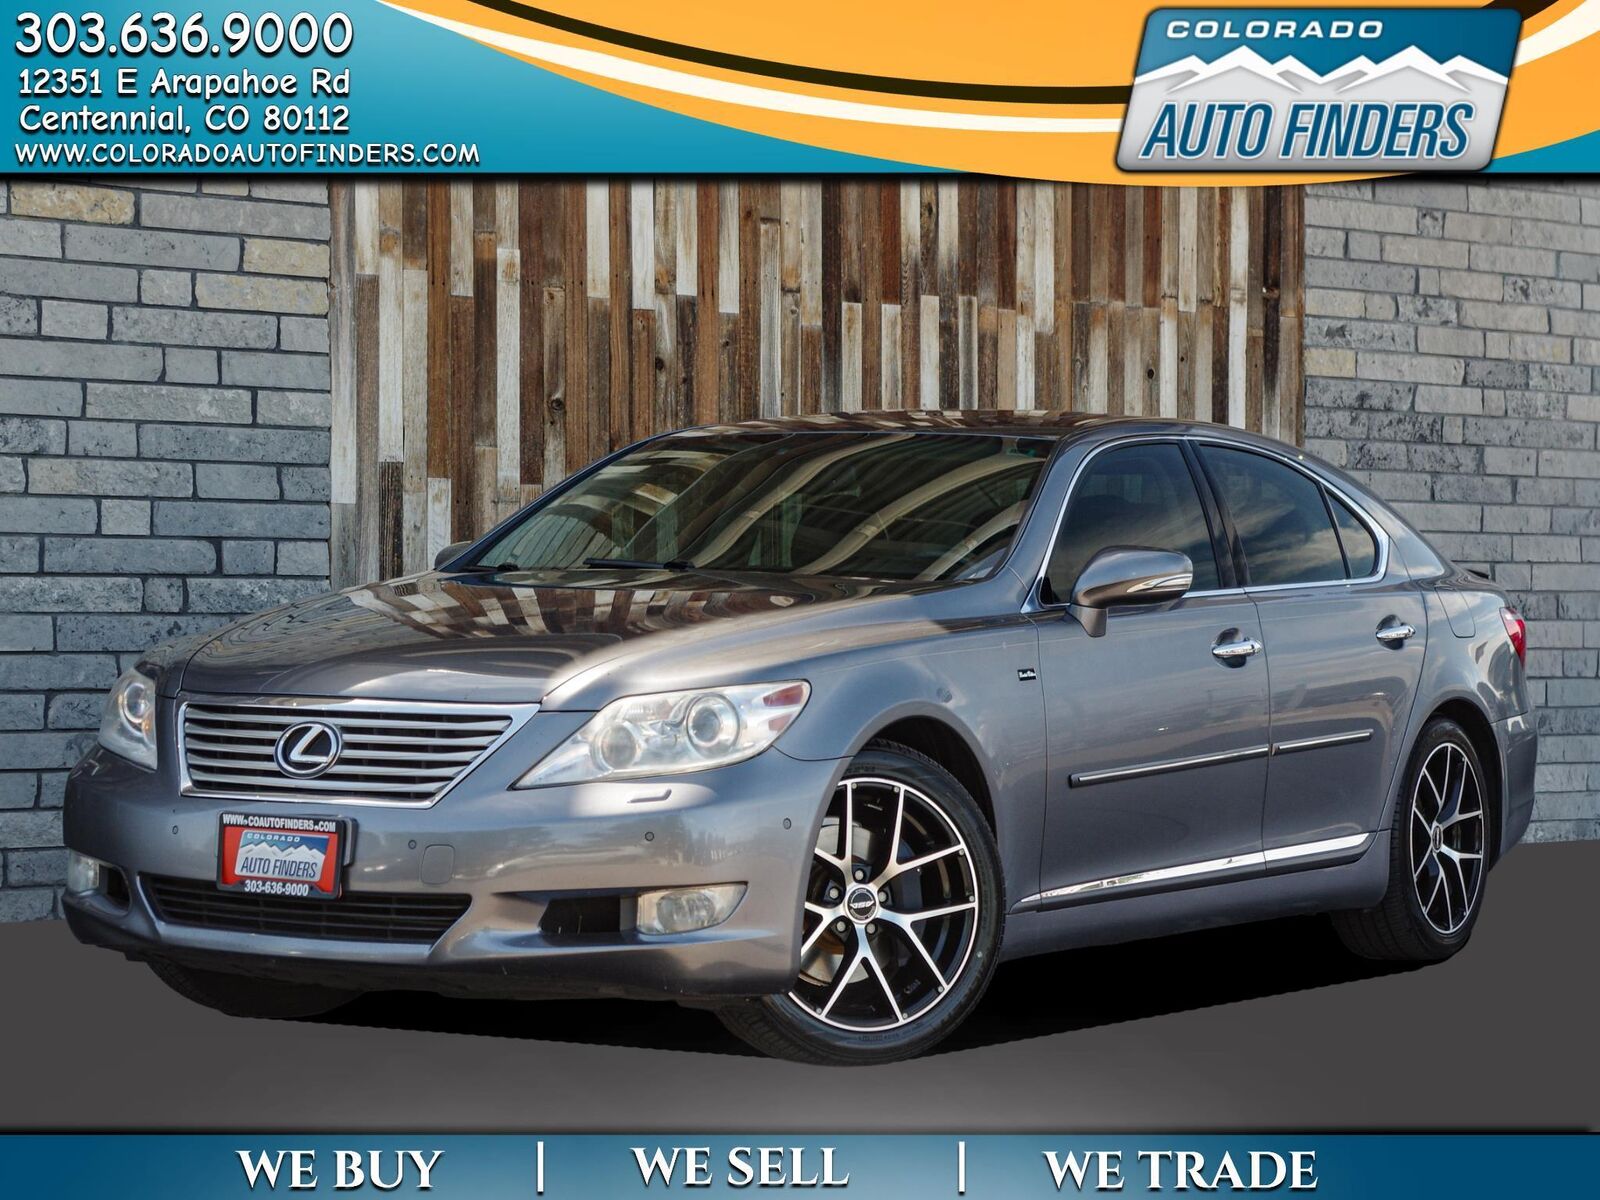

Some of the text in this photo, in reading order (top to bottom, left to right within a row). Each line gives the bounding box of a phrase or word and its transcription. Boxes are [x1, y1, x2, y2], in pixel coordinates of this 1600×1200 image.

[246, 832, 301, 843] COLORADO
[240, 856, 318, 879] AUTO FINDERS
[244, 879, 310, 897] 303-636-9000
